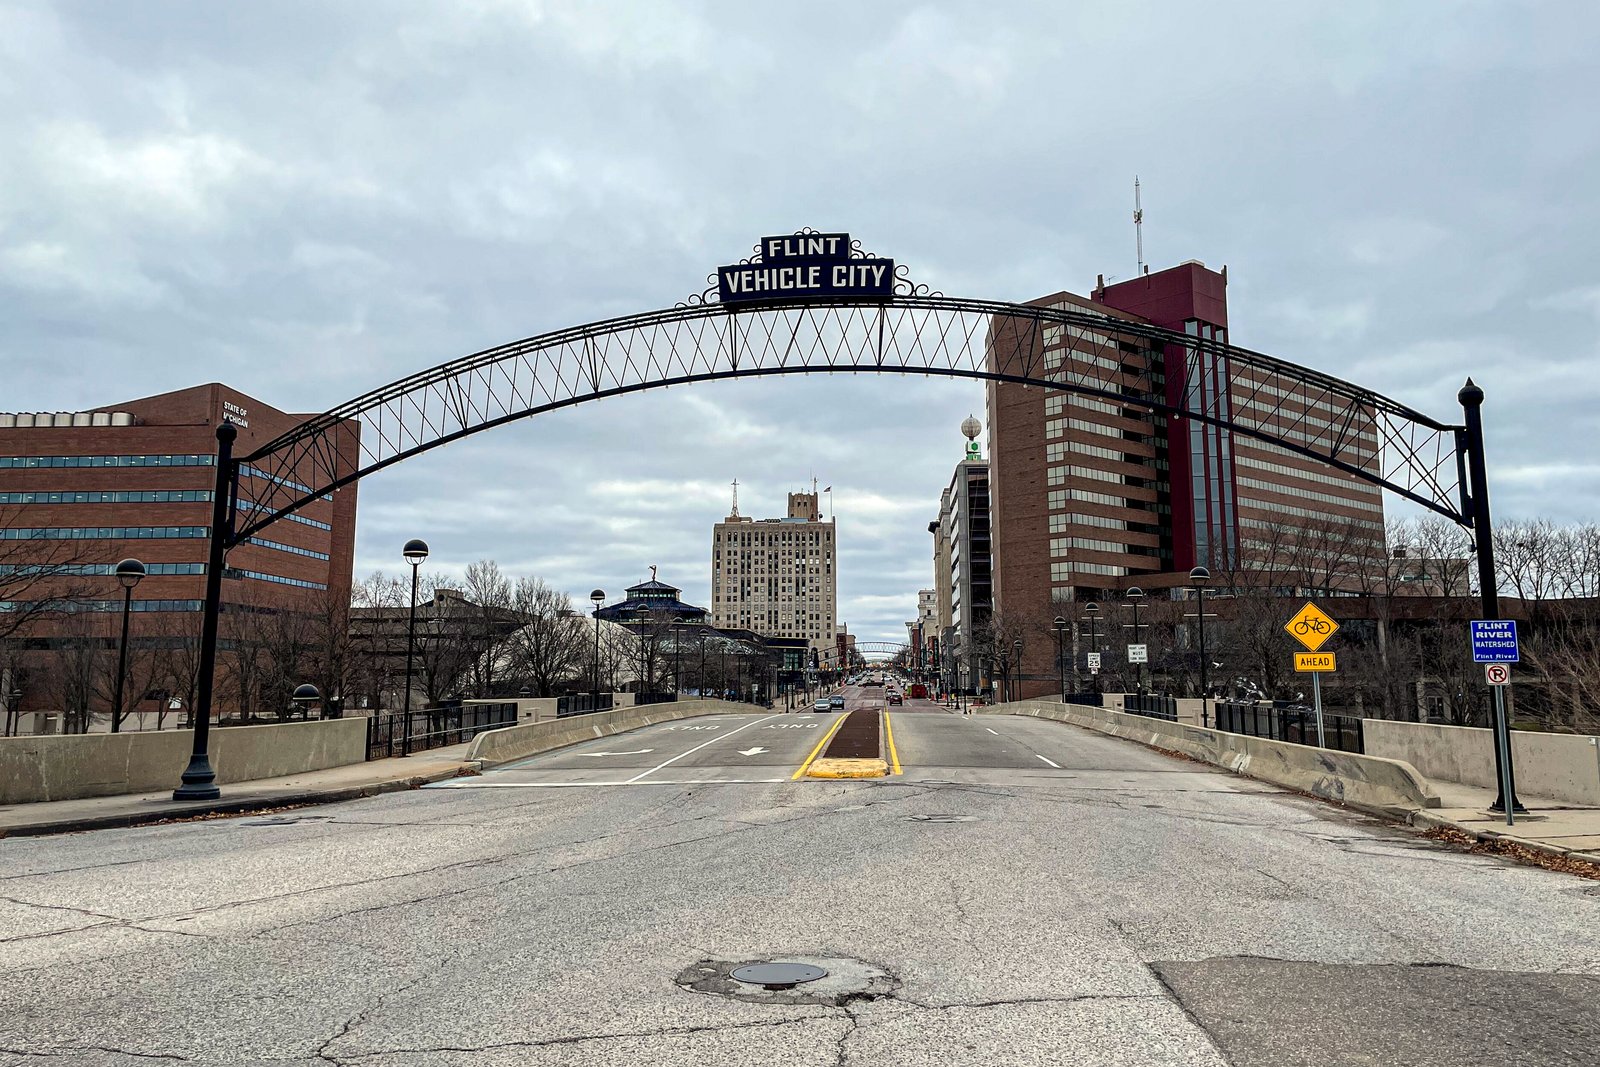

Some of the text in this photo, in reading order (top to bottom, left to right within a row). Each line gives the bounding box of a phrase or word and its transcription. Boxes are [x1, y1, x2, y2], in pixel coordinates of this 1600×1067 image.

[768, 237, 841, 257] FLINT
[725, 265, 886, 293] VEHICLE CITY
[223, 401, 248, 417] STATE OF
[222, 411, 249, 428] MCHIGAN
[1477, 622, 1509, 630] FLINT
[1475, 631, 1513, 639] RIVER
[1300, 657, 1330, 666] AHEAD
